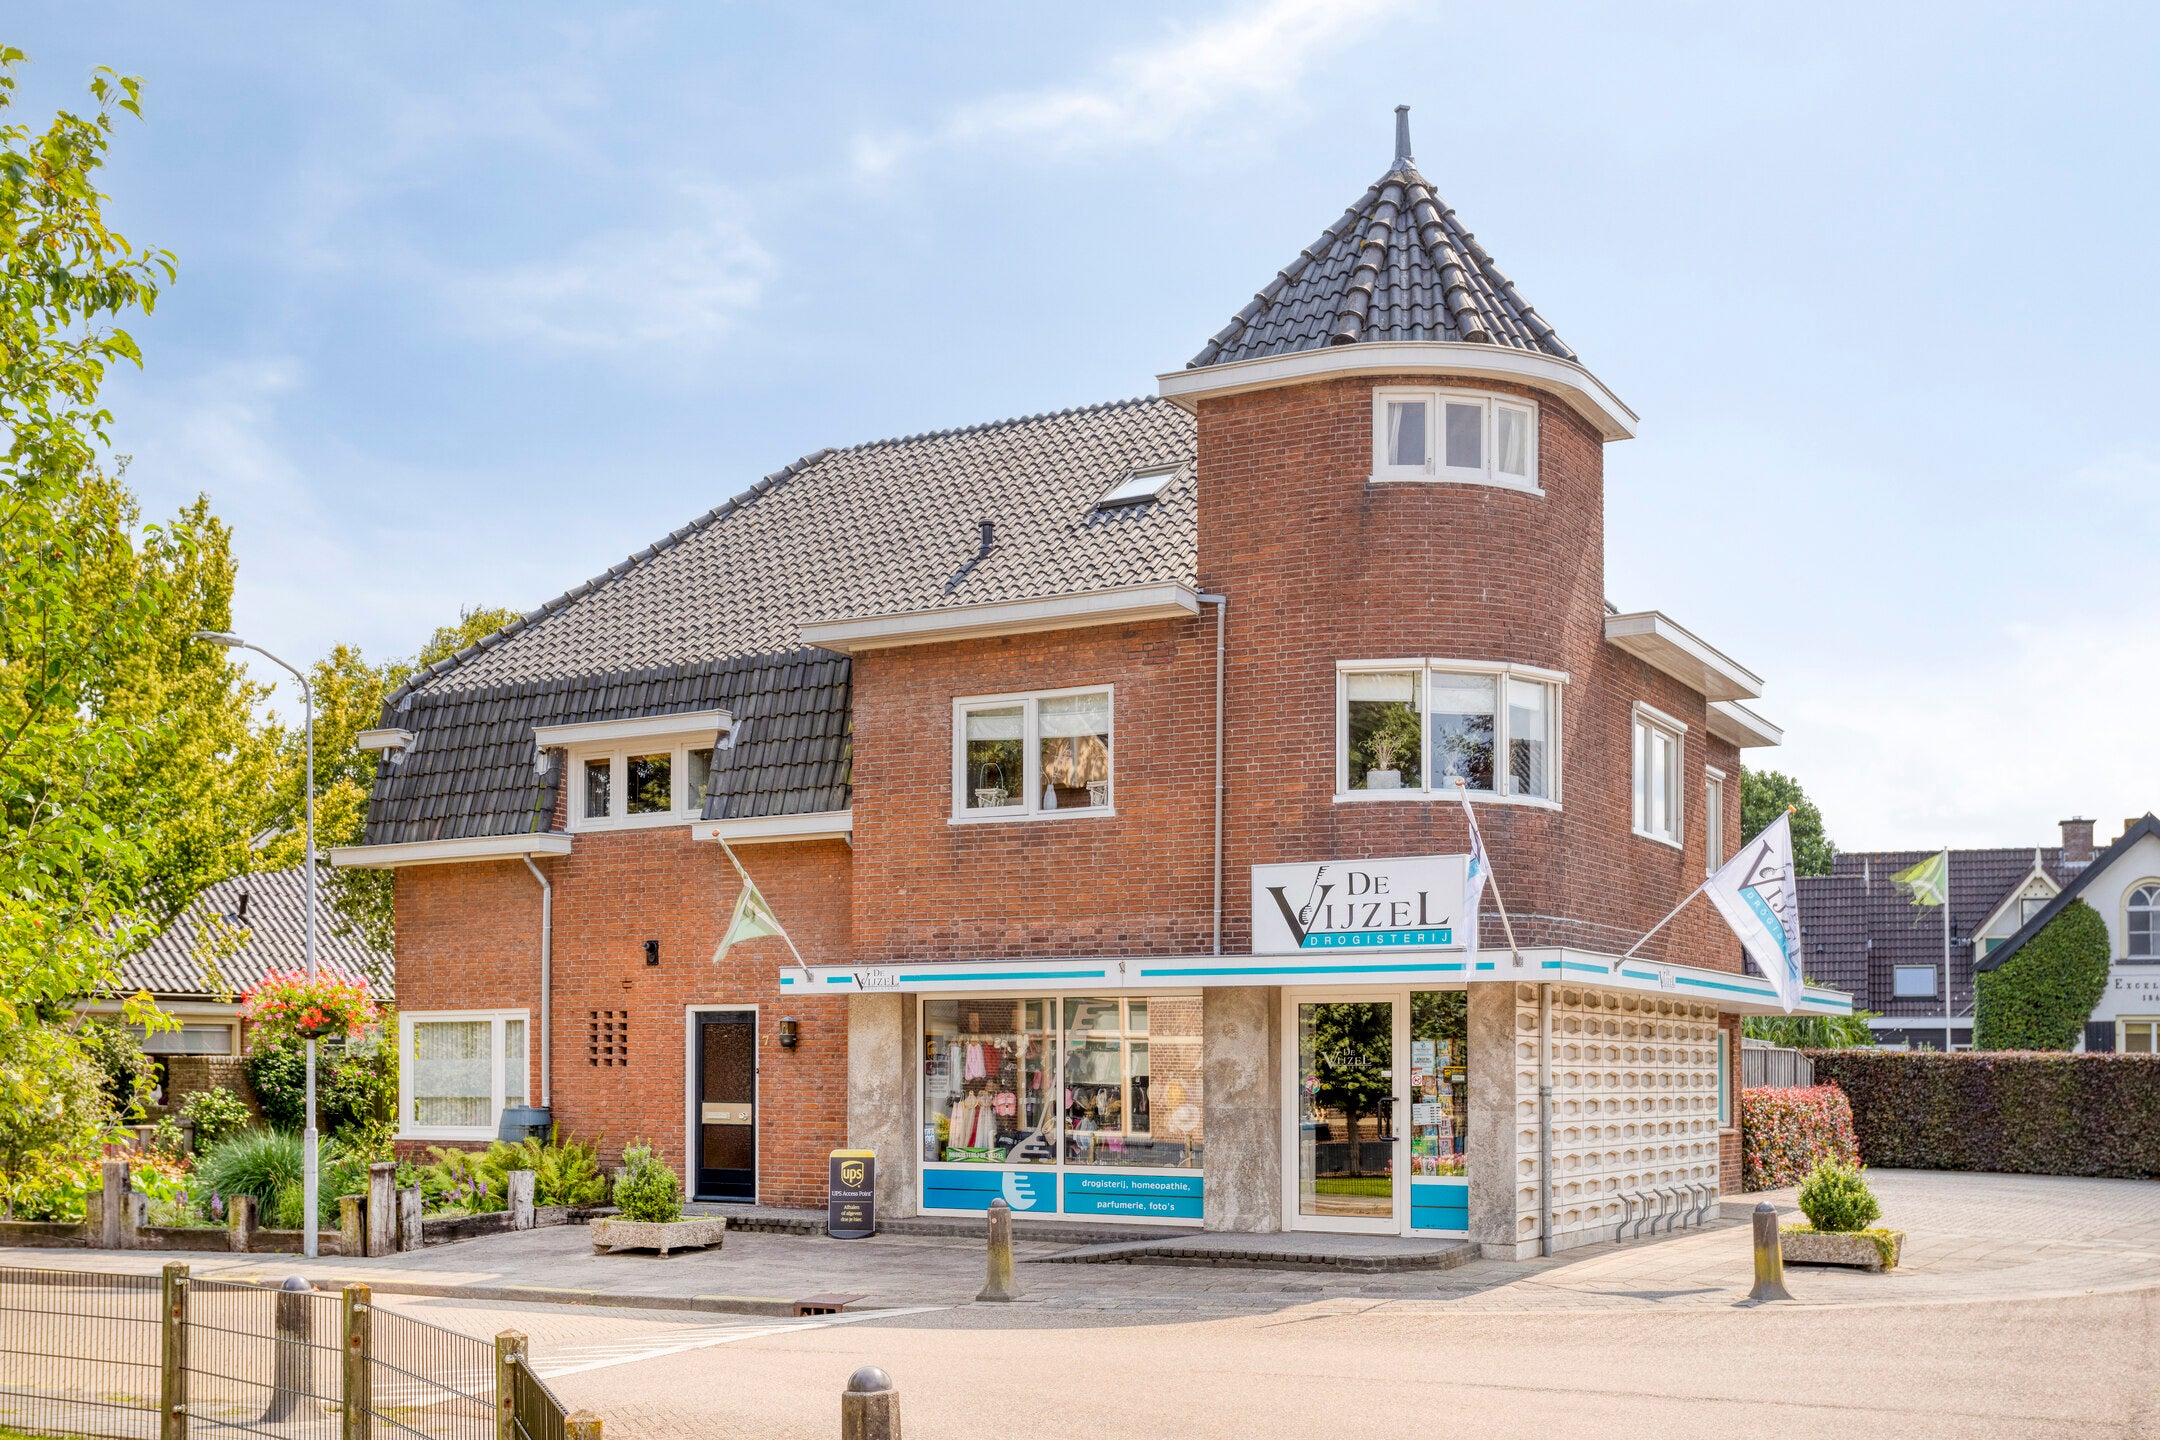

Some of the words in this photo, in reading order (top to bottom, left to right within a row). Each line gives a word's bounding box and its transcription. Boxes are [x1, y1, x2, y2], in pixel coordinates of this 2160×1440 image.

[1347, 871, 1390, 896] DE
[1265, 884, 1450, 948] VIJZEL
[1310, 933, 1448, 946] DROGISTERIJ
[762, 1035, 769, 1046] 7
[843, 1168, 862, 1183] ups
[1081, 1179, 1129, 1189] drogisterij,
[1131, 1180, 1191, 1191] homeopathie,
[1097, 1200, 1147, 1210] parfumerie,
[1149, 1201, 1175, 1211] foto's
